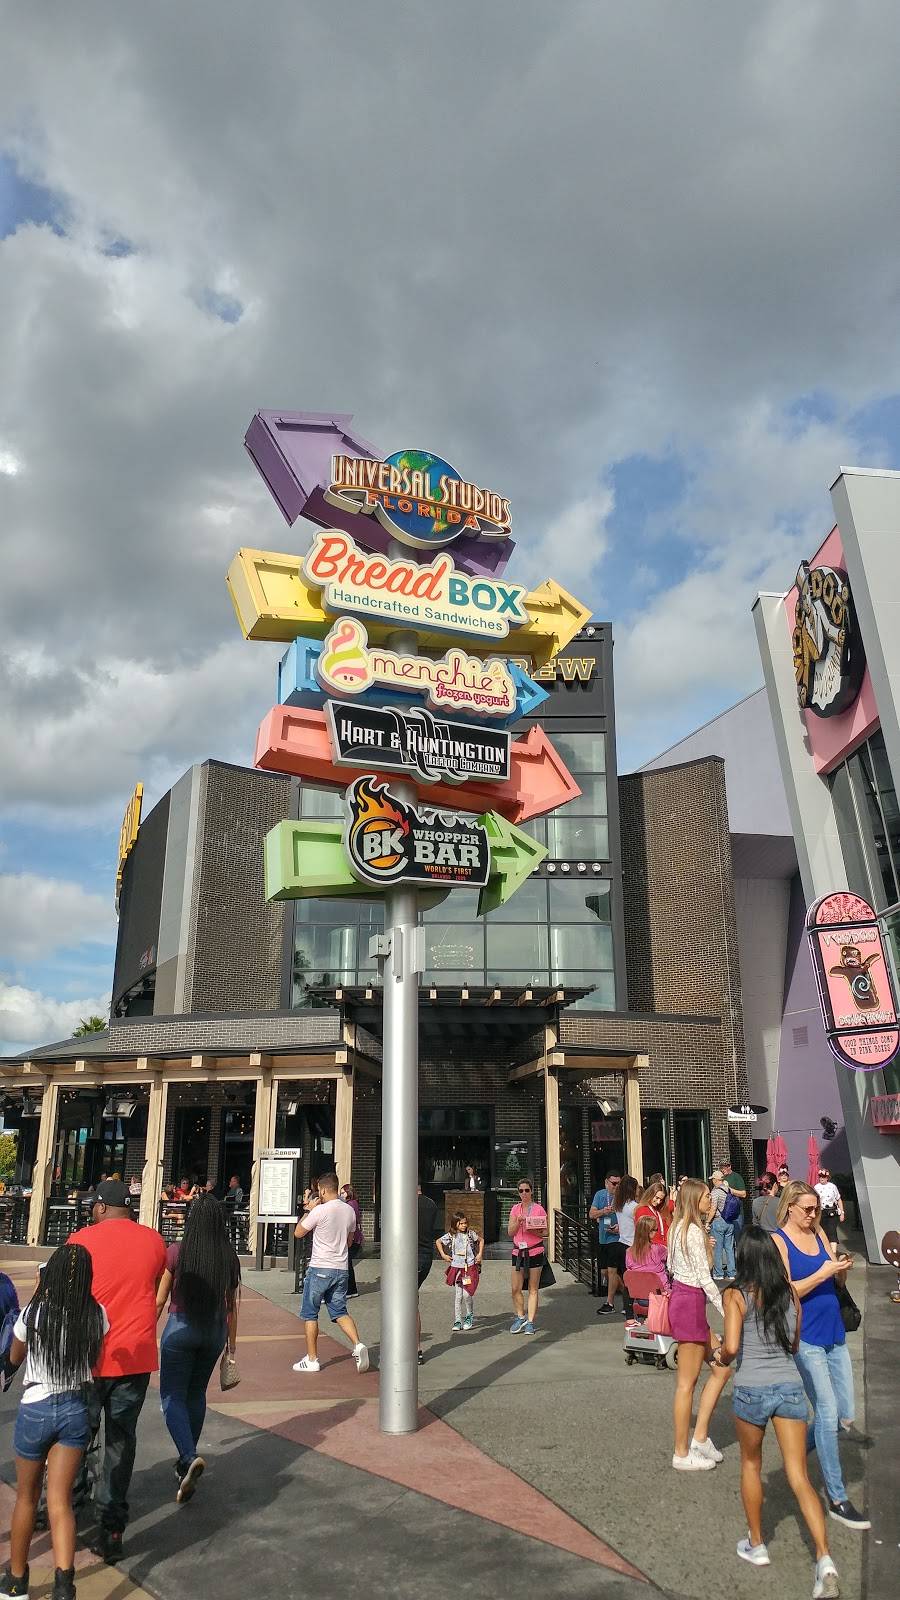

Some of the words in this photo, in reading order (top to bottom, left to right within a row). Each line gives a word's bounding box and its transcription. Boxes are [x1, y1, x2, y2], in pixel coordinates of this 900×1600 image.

[331, 455, 435, 500] UNIVERSAL
[439, 474, 512, 528] STUDIOS
[367, 492, 478, 529] FLORIDA
[311, 537, 447, 601] Bread
[448, 577, 523, 617] BOX
[333, 588, 420, 616] Handcrafted
[424, 607, 503, 632] Sandwiches
[373, 657, 508, 694] menchie's
[436, 683, 472, 701] frozen
[473, 694, 510, 708] yogurt
[341, 719, 385, 745] HART
[390, 732, 401, 749] &
[406, 730, 506, 763] HUNTINGTON
[363, 827, 405, 861] BK
[413, 829, 480, 845] WHOPPER
[414, 840, 481, 868] BAR
[424, 865, 452, 874] WORLD'S
[454, 866, 473, 876] FIRST
